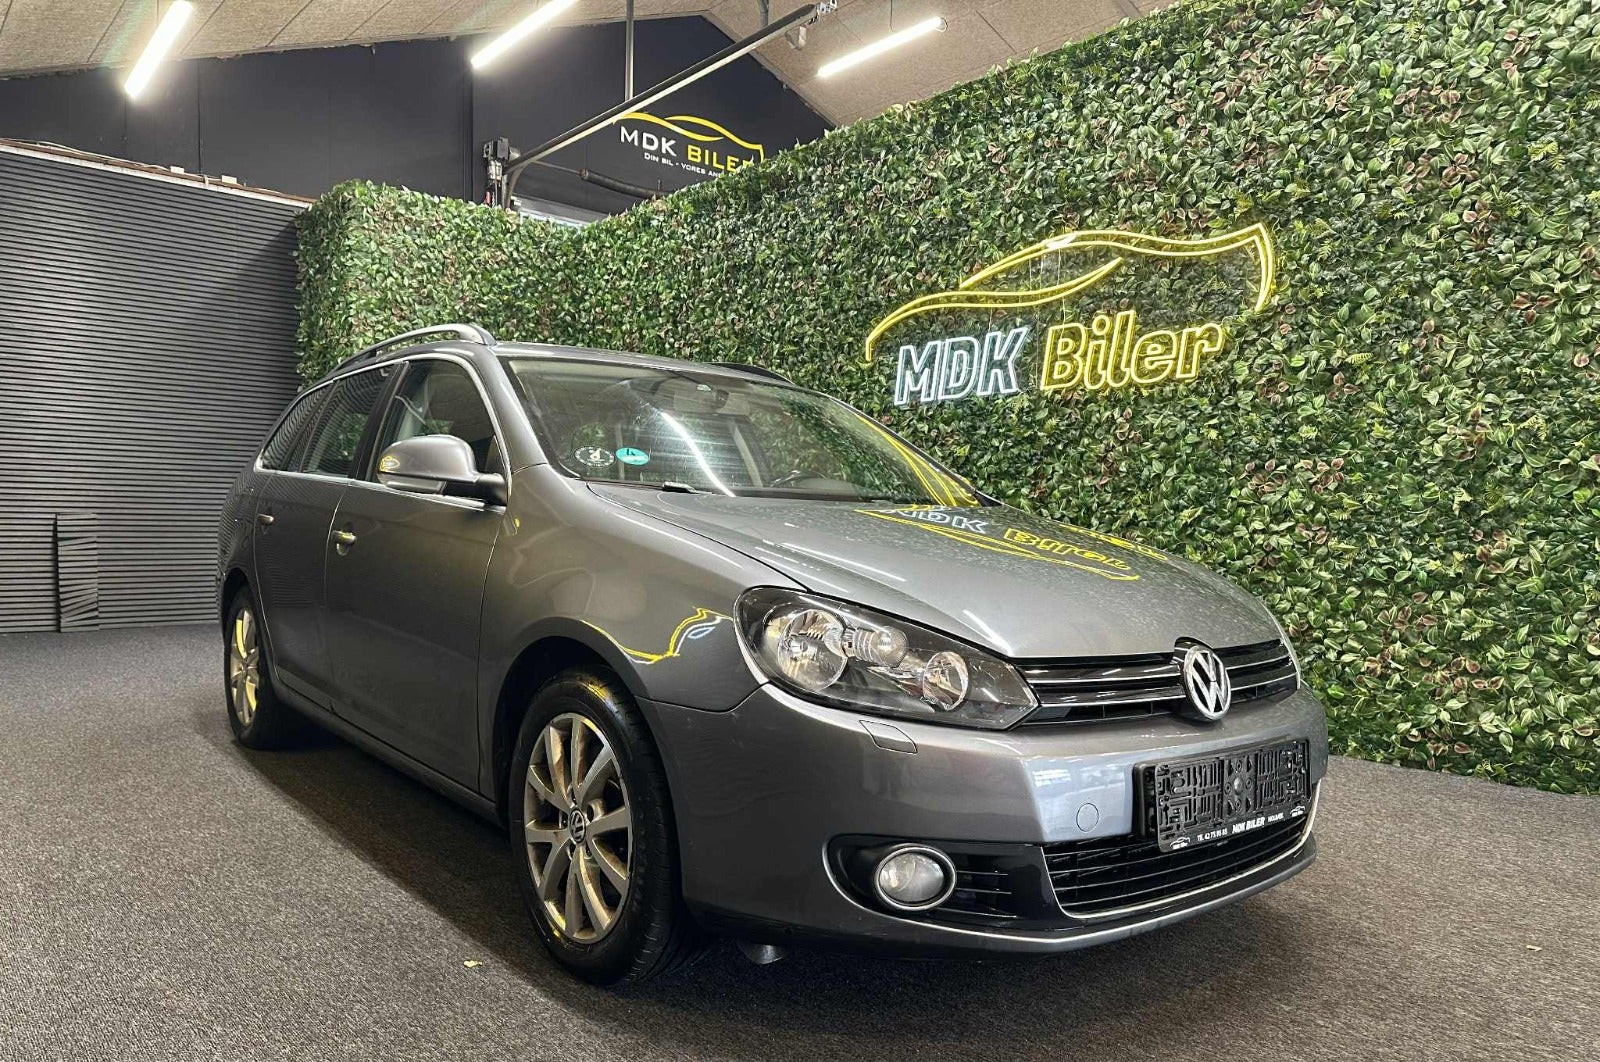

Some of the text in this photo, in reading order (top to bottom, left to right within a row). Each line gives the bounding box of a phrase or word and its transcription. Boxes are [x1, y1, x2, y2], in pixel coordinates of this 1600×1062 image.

[620, 126, 677, 157] MDK
[661, 158, 674, 167] BIL
[894, 310, 1224, 405] MDK Biler
